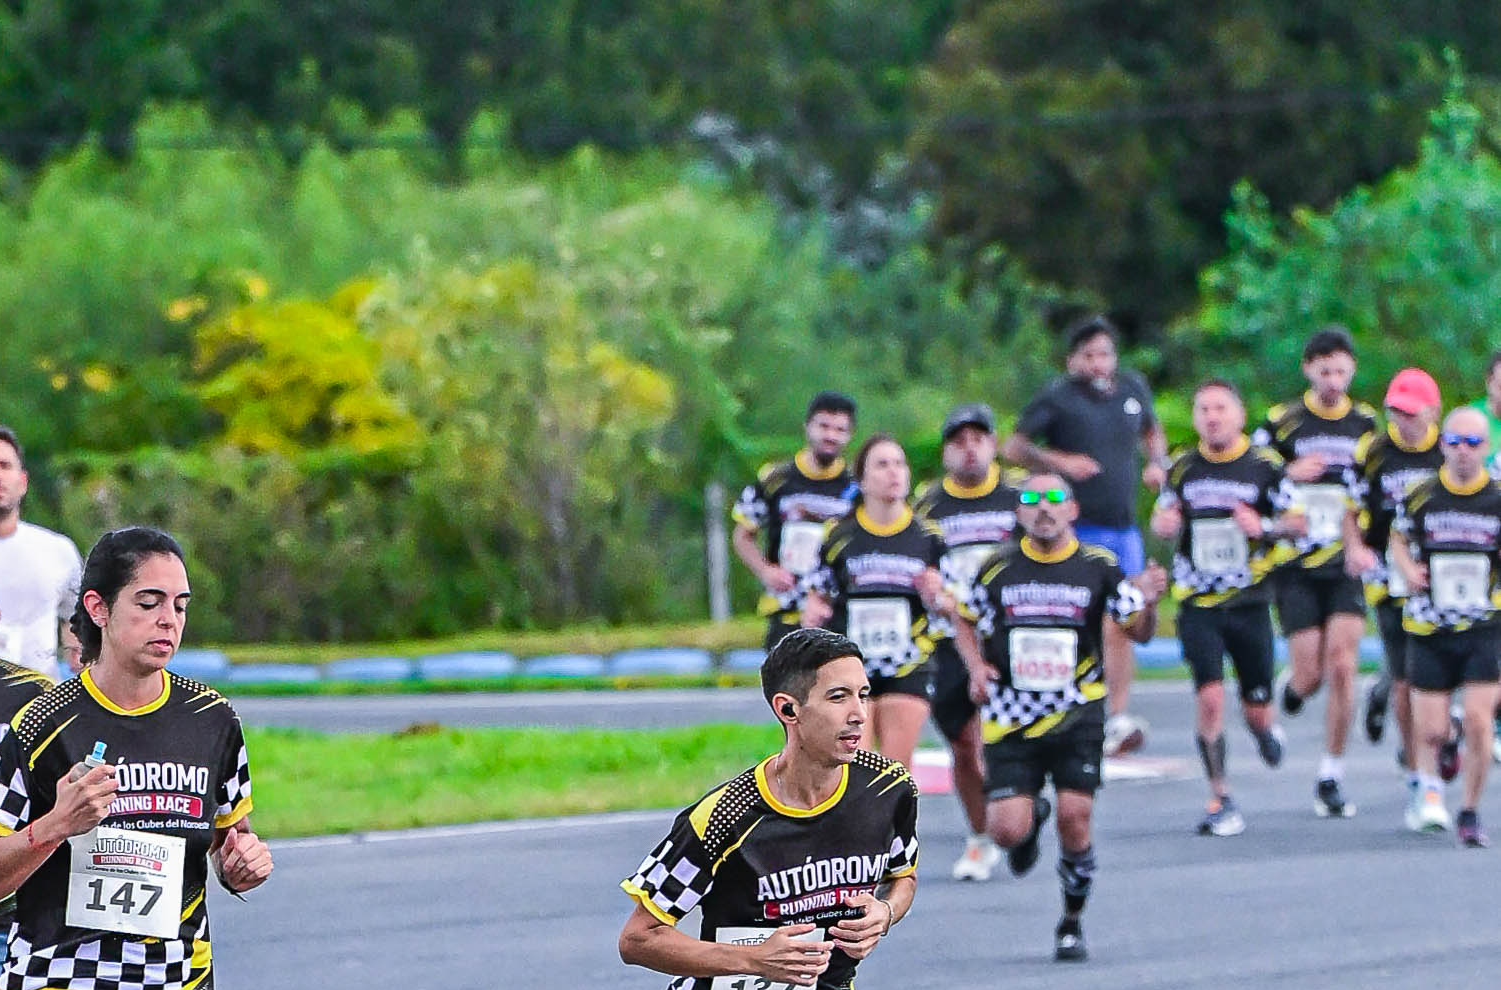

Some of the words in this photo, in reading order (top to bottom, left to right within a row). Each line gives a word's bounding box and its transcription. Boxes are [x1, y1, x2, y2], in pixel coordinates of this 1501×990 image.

[114, 756, 210, 795] ÓDROMO
[107, 795, 153, 814] NNING
[155, 795, 191, 814] RACE
[123, 821, 135, 830] los
[136, 819, 164, 830] Clubes
[165, 819, 179, 829] del
[88, 834, 169, 862] AUTÓDROMO
[86, 878, 163, 916] 147
[779, 891, 837, 916] RUNNING
